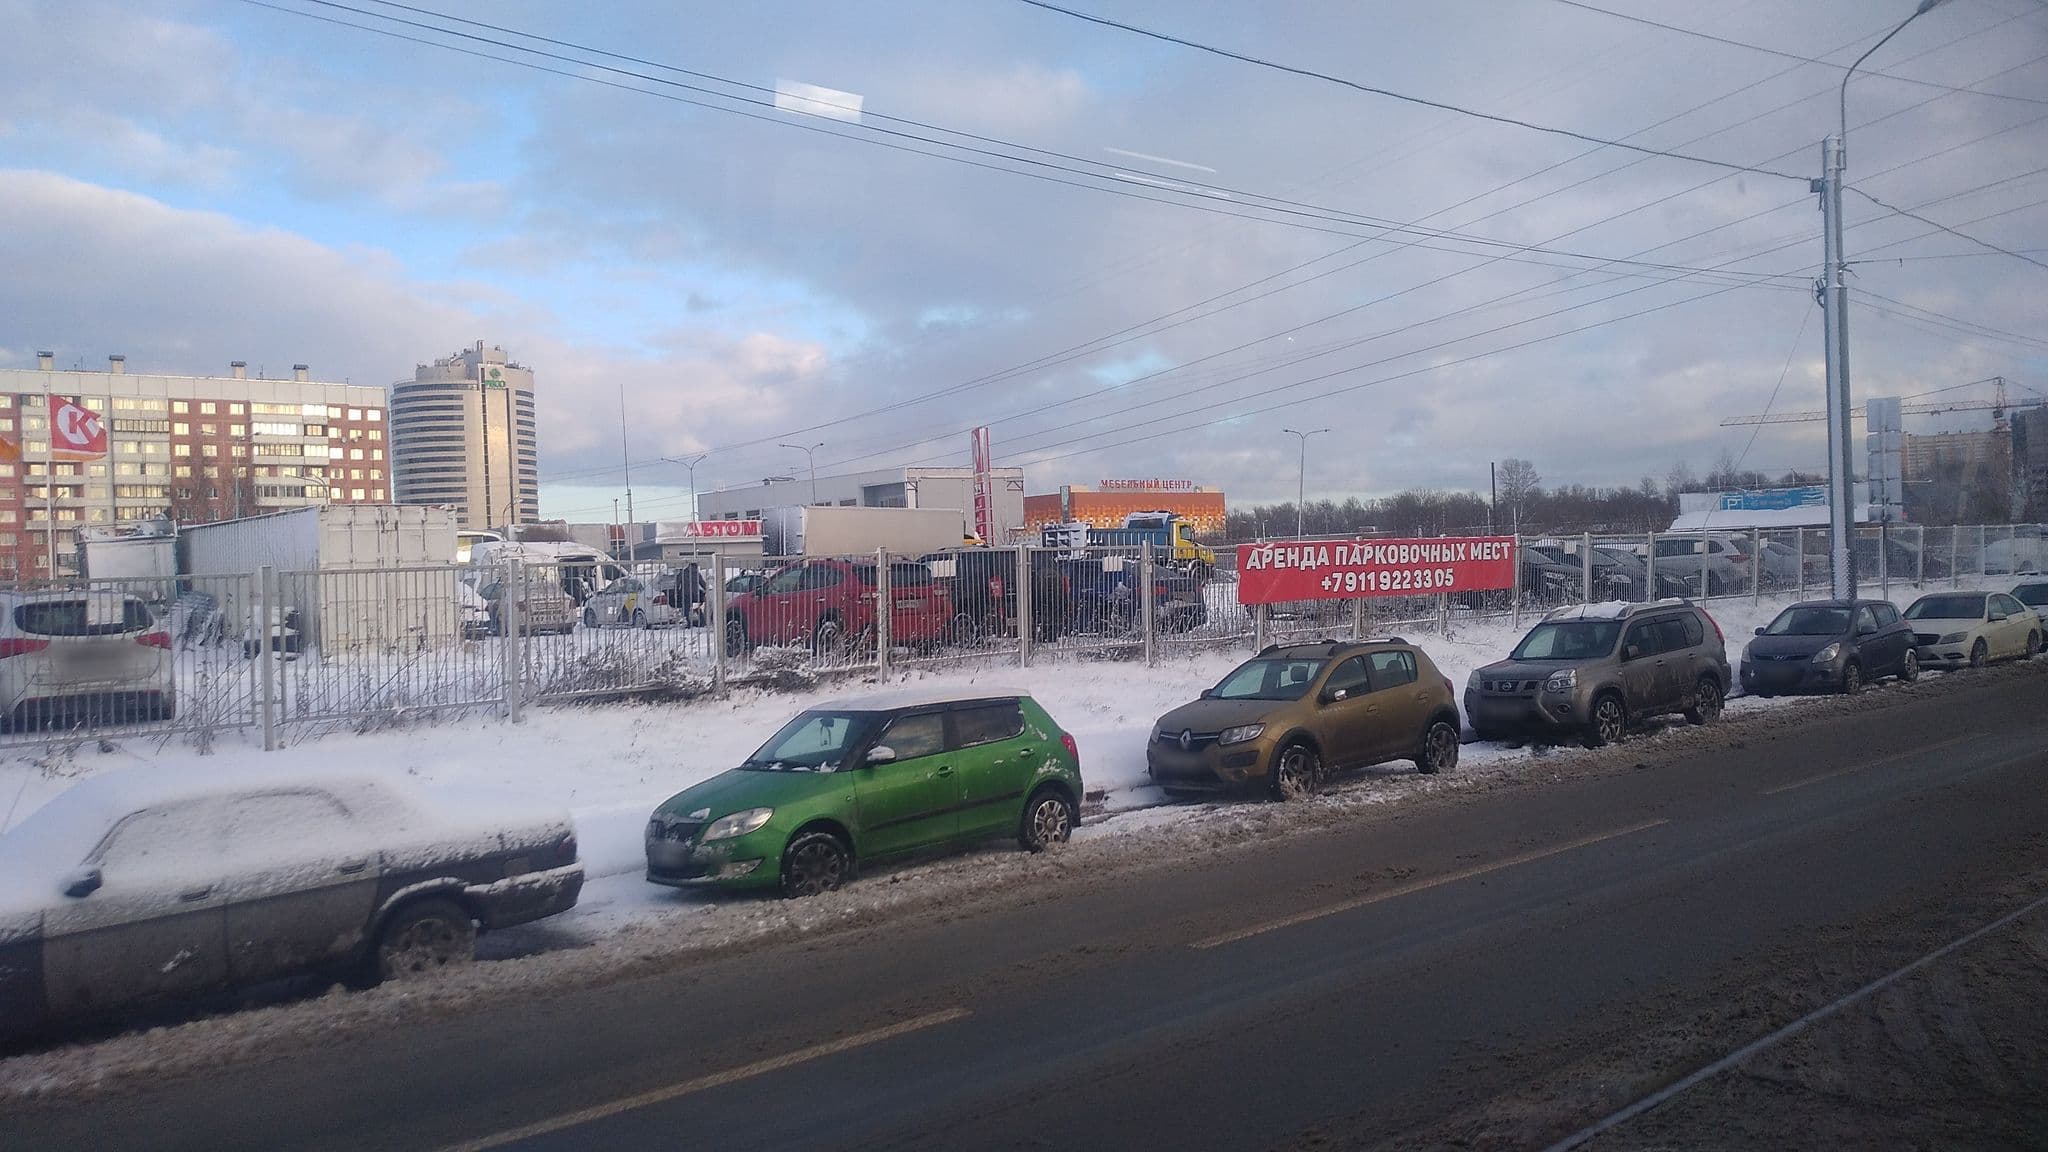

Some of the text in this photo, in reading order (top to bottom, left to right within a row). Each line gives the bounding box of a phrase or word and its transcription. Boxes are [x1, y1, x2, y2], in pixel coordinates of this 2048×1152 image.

[1100, 478, 1193, 491] МЕБЕЛЬНЫЙ ЦЕНТР
[685, 521, 763, 538] АВТОМ
[1245, 541, 1510, 571] АРЕНДА ПАРКОВОЧНЫХ МЕСТ
